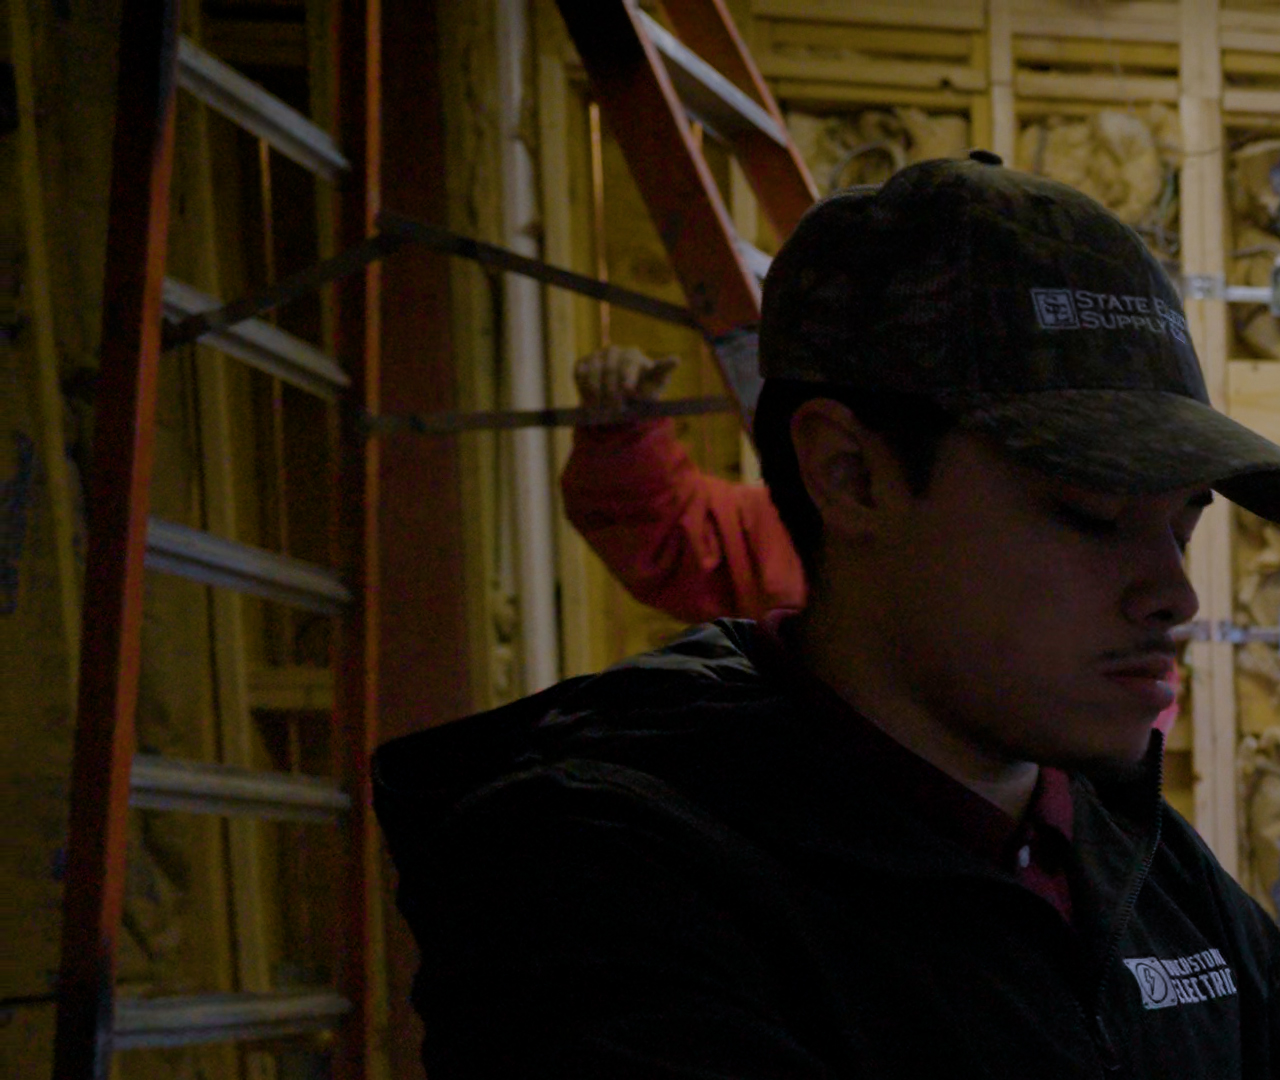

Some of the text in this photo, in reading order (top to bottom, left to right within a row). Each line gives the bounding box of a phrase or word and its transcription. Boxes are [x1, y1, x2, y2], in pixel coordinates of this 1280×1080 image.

[1075, 290, 1151, 313] STATE
[1080, 310, 1167, 333] SUPPLY
[1172, 967, 1238, 1004] ELECTRIC
